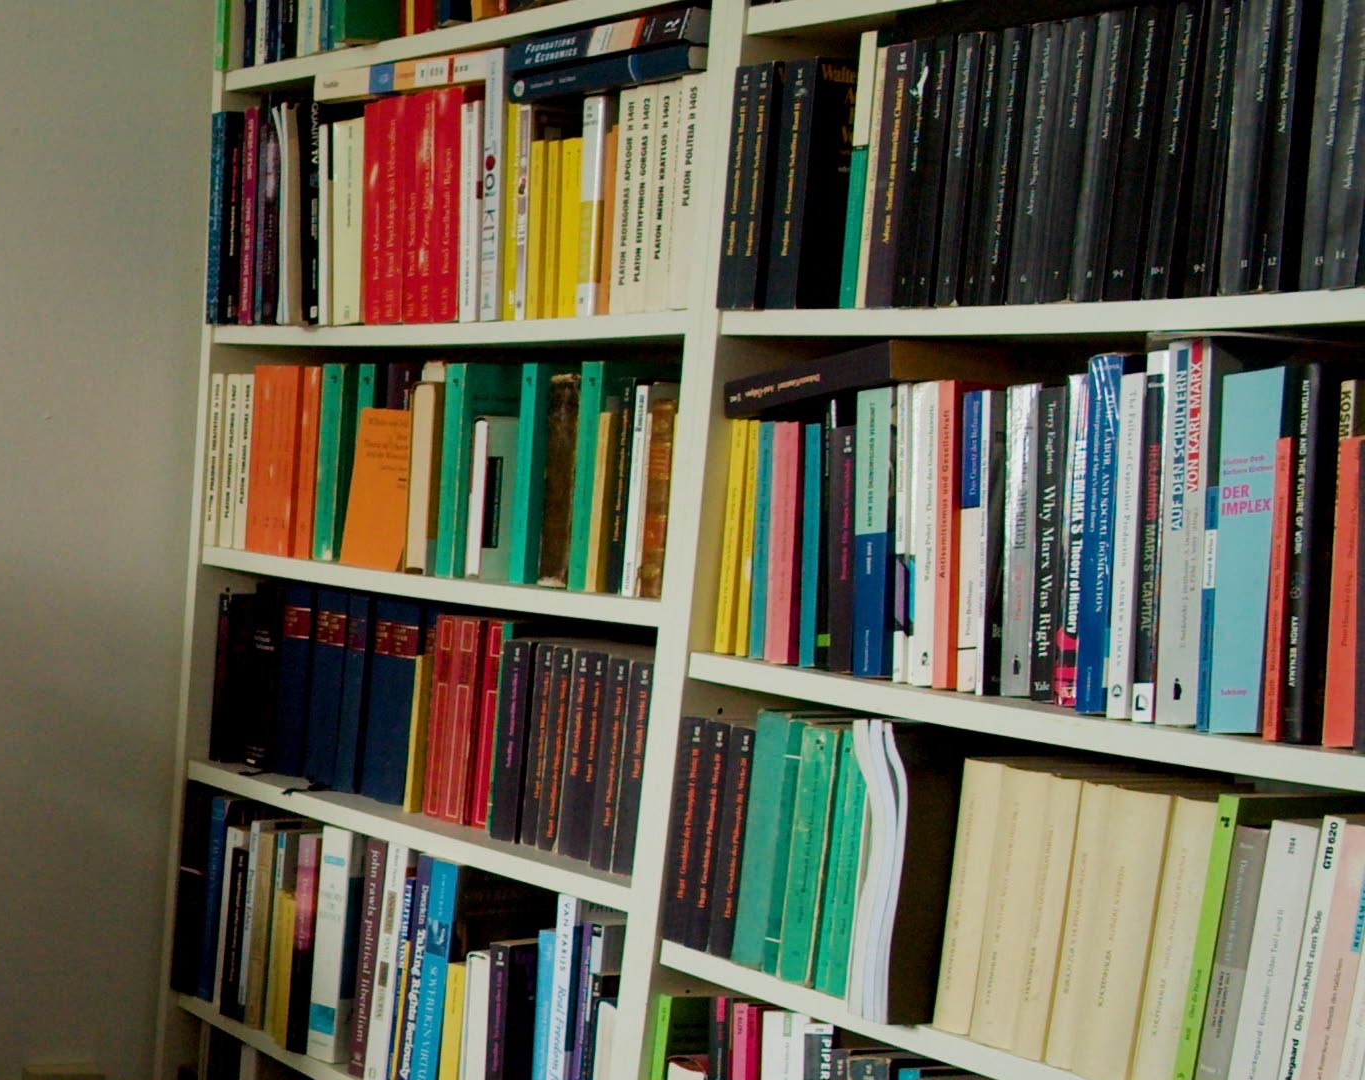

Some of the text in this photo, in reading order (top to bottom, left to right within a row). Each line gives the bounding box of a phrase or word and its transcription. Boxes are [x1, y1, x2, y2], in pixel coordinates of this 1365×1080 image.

[311, 149, 318, 164] TV
[624, 138, 633, 180] APOLOGIE
[658, 134, 668, 179] KRATYLOS
[685, 124, 695, 165] POLITEIA
[633, 248, 642, 282] PLATON
[639, 136, 649, 176] GORGIAS
[656, 186, 665, 220] MENON
[681, 171, 692, 206] PLATON
[621, 188, 631, 246] PROTAGORAS
[653, 225, 663, 259] PLATON
[619, 252, 628, 285] PLATON
[1187, 360, 1203, 492] VON KARL MARX
[1171, 369, 1187, 530] AUF DEN SCHULTERN
[1293, 380, 1310, 554] AUTOMATION AND THE FUTURE OF WORK
[1221, 498, 1271, 516] IMPLEX
[1222, 485, 1250, 500] DER
[1037, 402, 1056, 658] Terry Eagleton Why Marx Was Right
[1142, 524, 1157, 572] MARX'S
[1067, 540, 1082, 578] Theory
[1065, 592, 1080, 633] History
[1289, 616, 1299, 646] AARON
[1321, 822, 1339, 869] GTB 620
[1311, 910, 1323, 934] Tode
[356, 849, 380, 1042] john rawls political liberalism
[408, 928, 427, 976] Taking
[1309, 936, 1319, 958] zum
[403, 978, 423, 1020] Rights
[555, 985, 567, 1013] Real
[1297, 960, 1316, 1012] Krankheit
[551, 1016, 565, 1070] Freedom
[1293, 1014, 1304, 1031] Die
[399, 1023, 417, 1080] Seriously
[820, 1038, 831, 1080] PIPER
